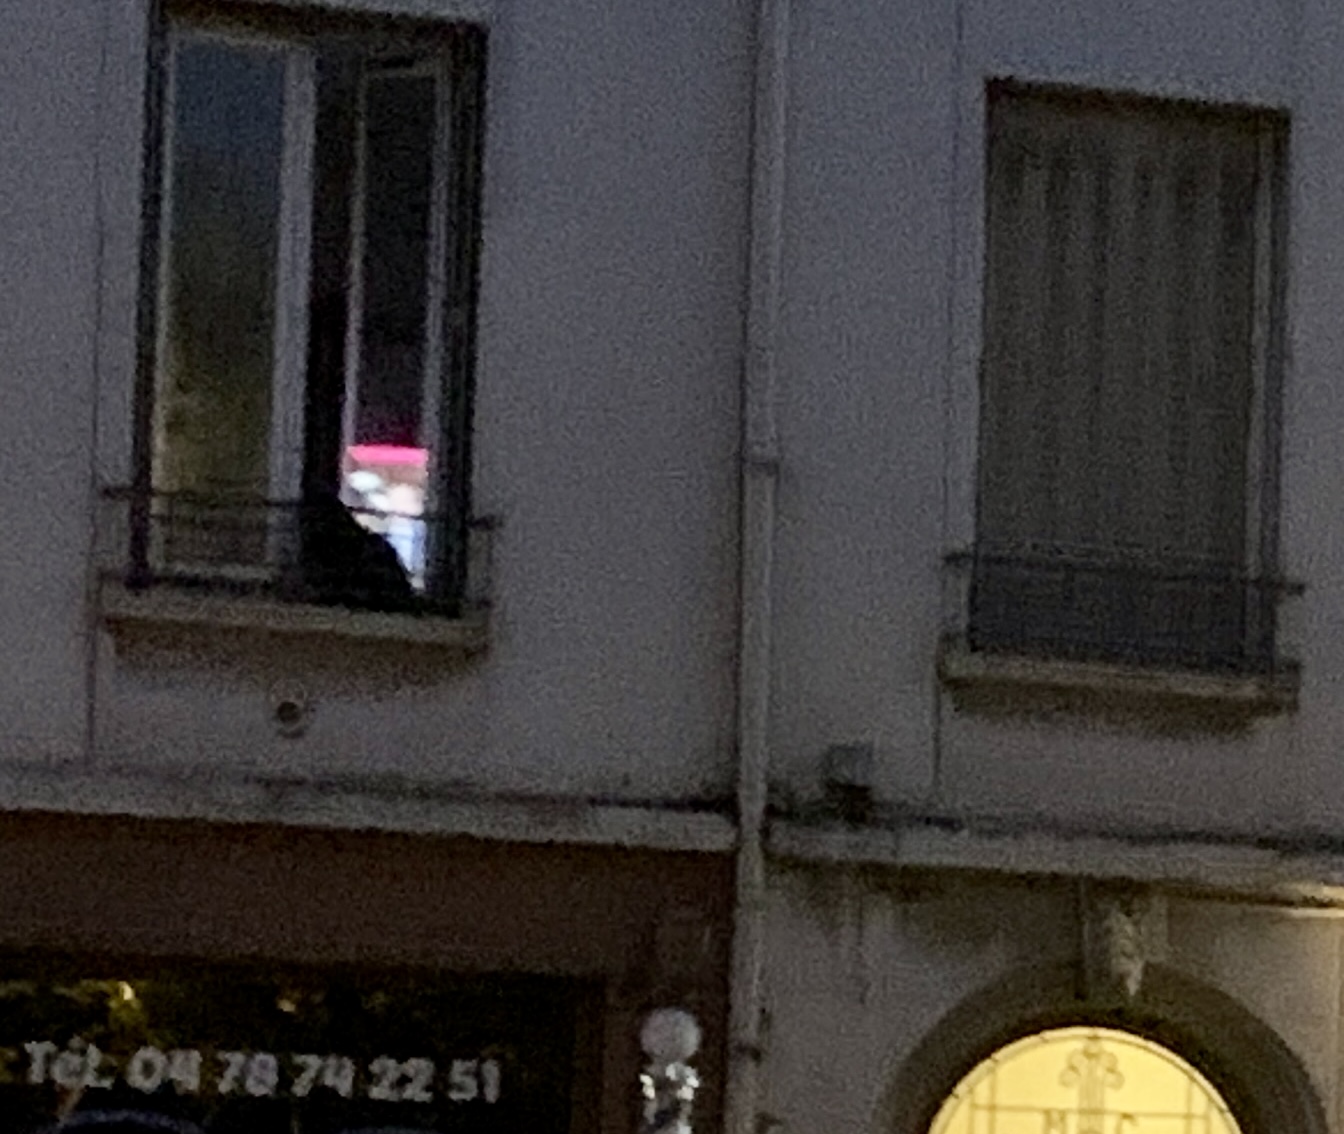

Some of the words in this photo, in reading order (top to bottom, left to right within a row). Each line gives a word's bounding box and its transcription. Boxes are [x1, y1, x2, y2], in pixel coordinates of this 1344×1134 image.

[125, 1046, 201, 1094] 04
[217, 1050, 279, 1098] 78
[291, 1053, 356, 1100] 74
[368, 1056, 434, 1102] 22
[447, 1057, 500, 1104] 51
